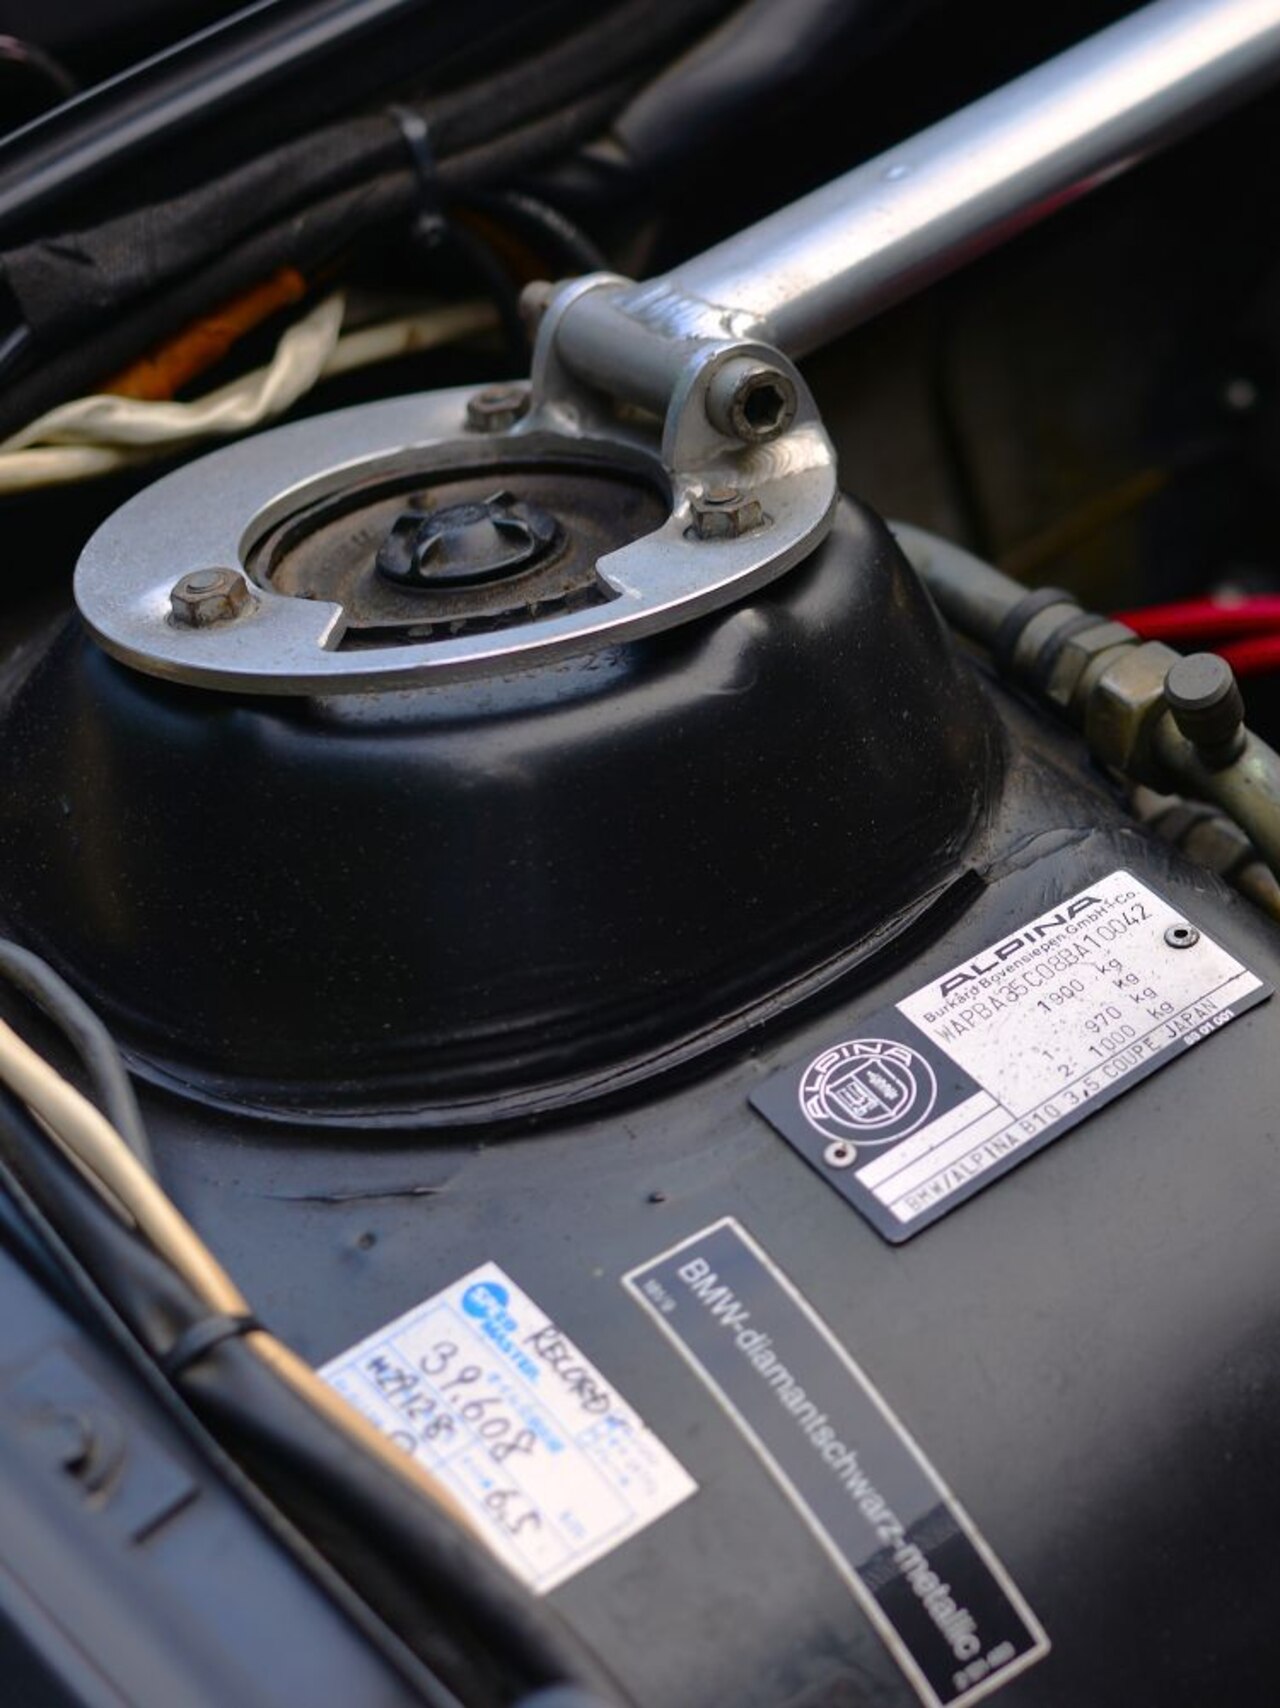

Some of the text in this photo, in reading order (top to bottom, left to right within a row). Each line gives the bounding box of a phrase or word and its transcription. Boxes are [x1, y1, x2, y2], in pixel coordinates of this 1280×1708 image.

[940, 895, 1102, 998] ALPINA
[1085, 1007, 1122, 1034] 970
[1129, 985, 1157, 1005] kg
[1112, 971, 1140, 990] kg
[1089, 1024, 1136, 1057] 1000
[1148, 1000, 1175, 1020] kg
[1102, 1036, 1159, 1079] COUPE
[1166, 1000, 1218, 1038] JAPAN
[807, 1042, 915, 1120] ALPINA
